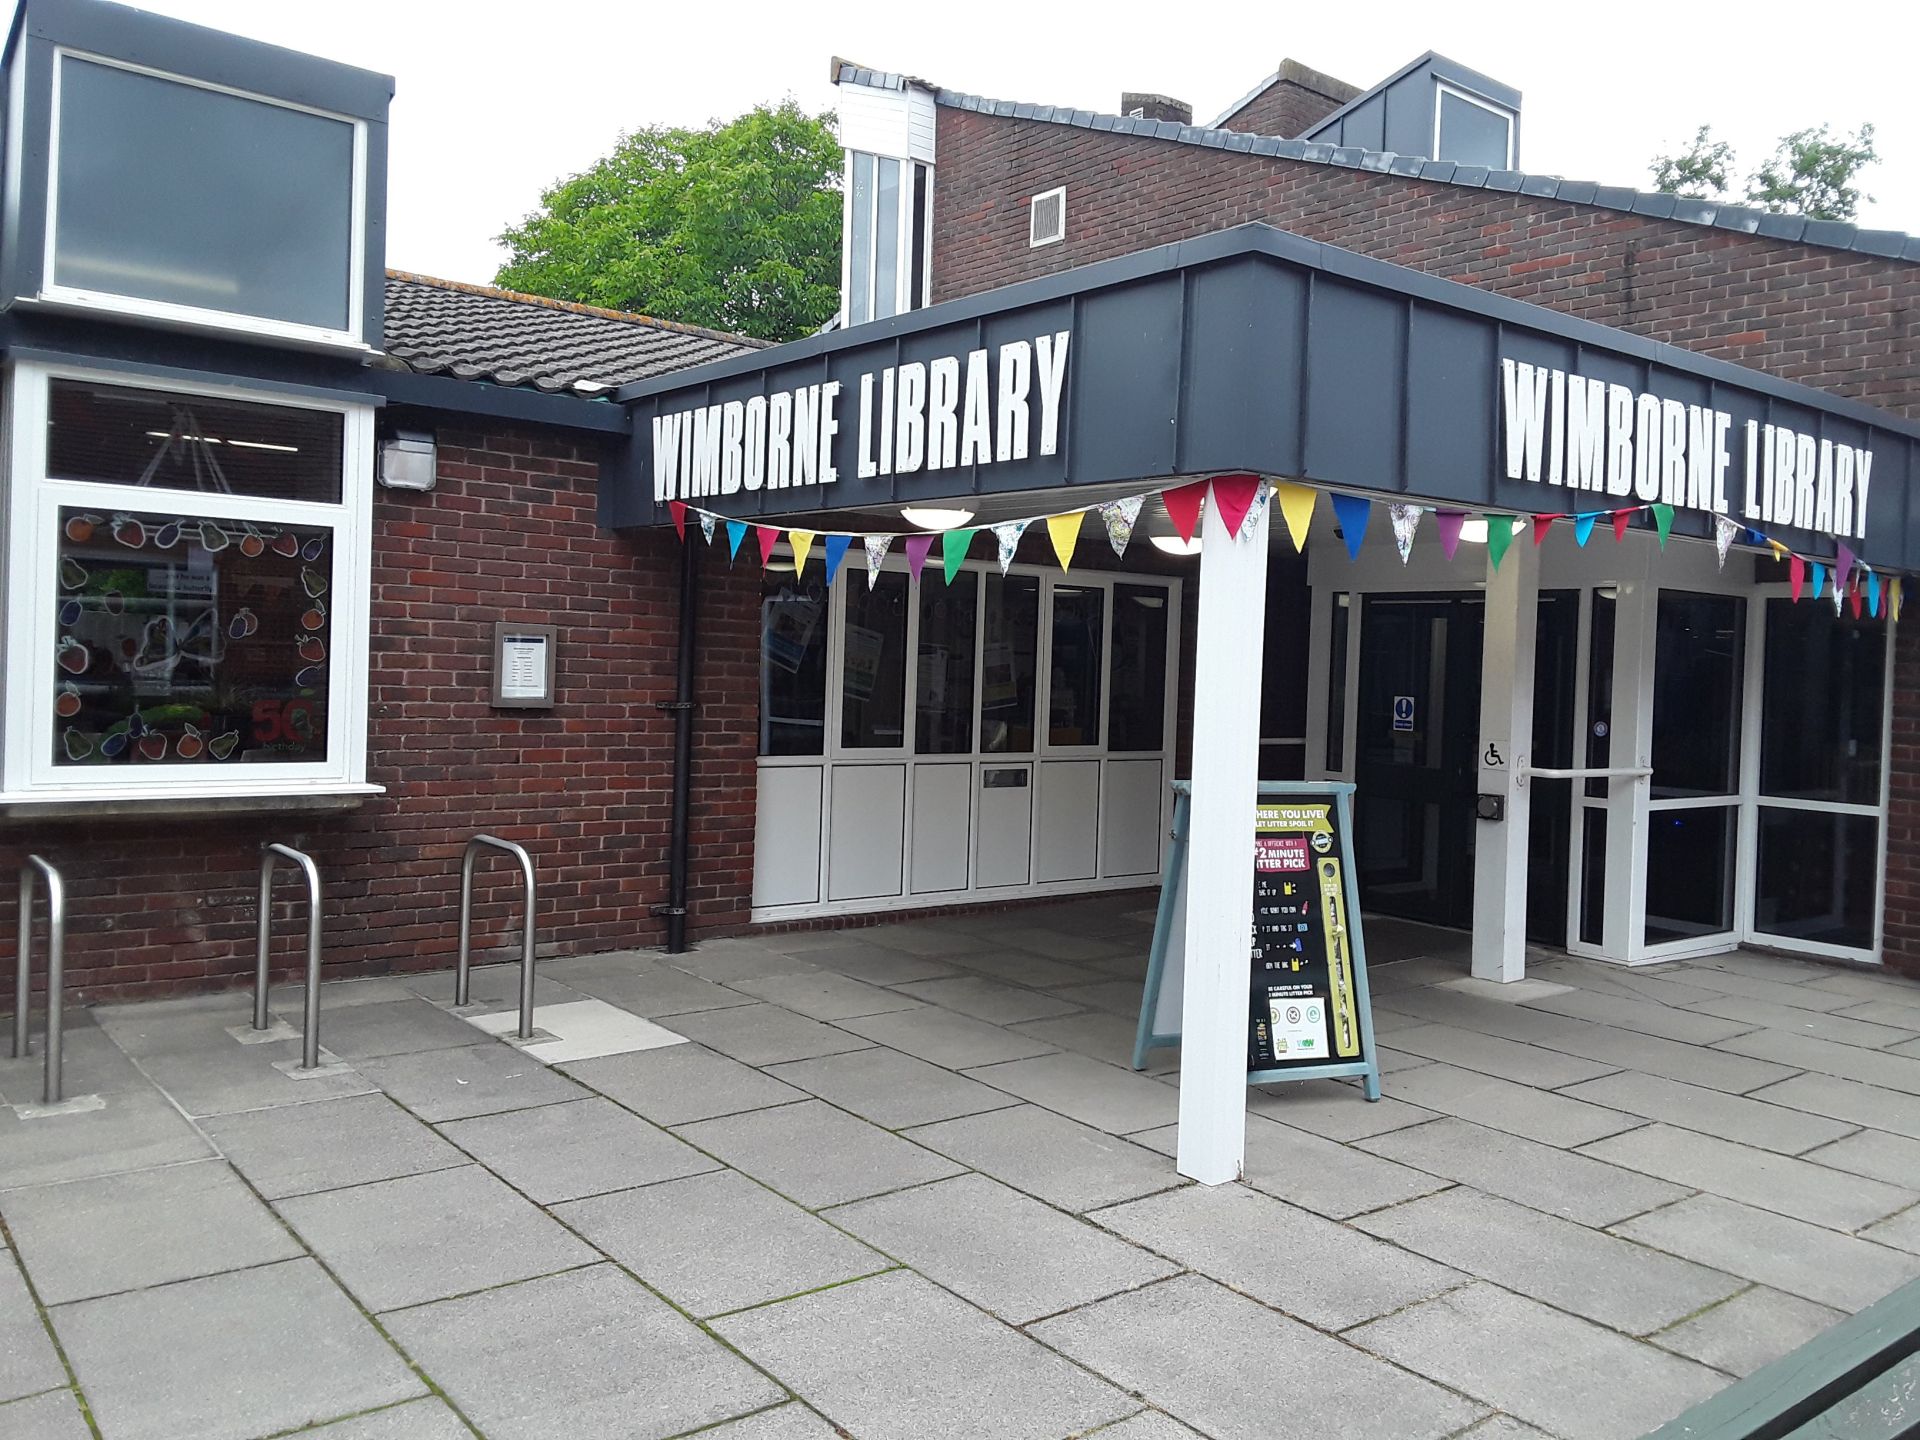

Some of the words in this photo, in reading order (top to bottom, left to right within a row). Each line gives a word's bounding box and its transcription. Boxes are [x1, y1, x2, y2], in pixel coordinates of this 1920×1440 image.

[653, 381, 839, 501] WIMBORNE
[857, 331, 1070, 478] LIBRARY
[1503, 358, 1731, 514] WIMBORNE
[1745, 419, 1872, 539] LIBRARY
[1256, 809, 1279, 819] HERE
[1281, 809, 1301, 819] YOU
[1303, 809, 1324, 819] LIVE!
[1267, 820, 1288, 828] LITTER
[1289, 820, 1307, 828] SPOIL
[1268, 849, 1305, 859] MINUTE
[1256, 859, 1282, 869] ITTER
[1283, 859, 1305, 868] PICK
